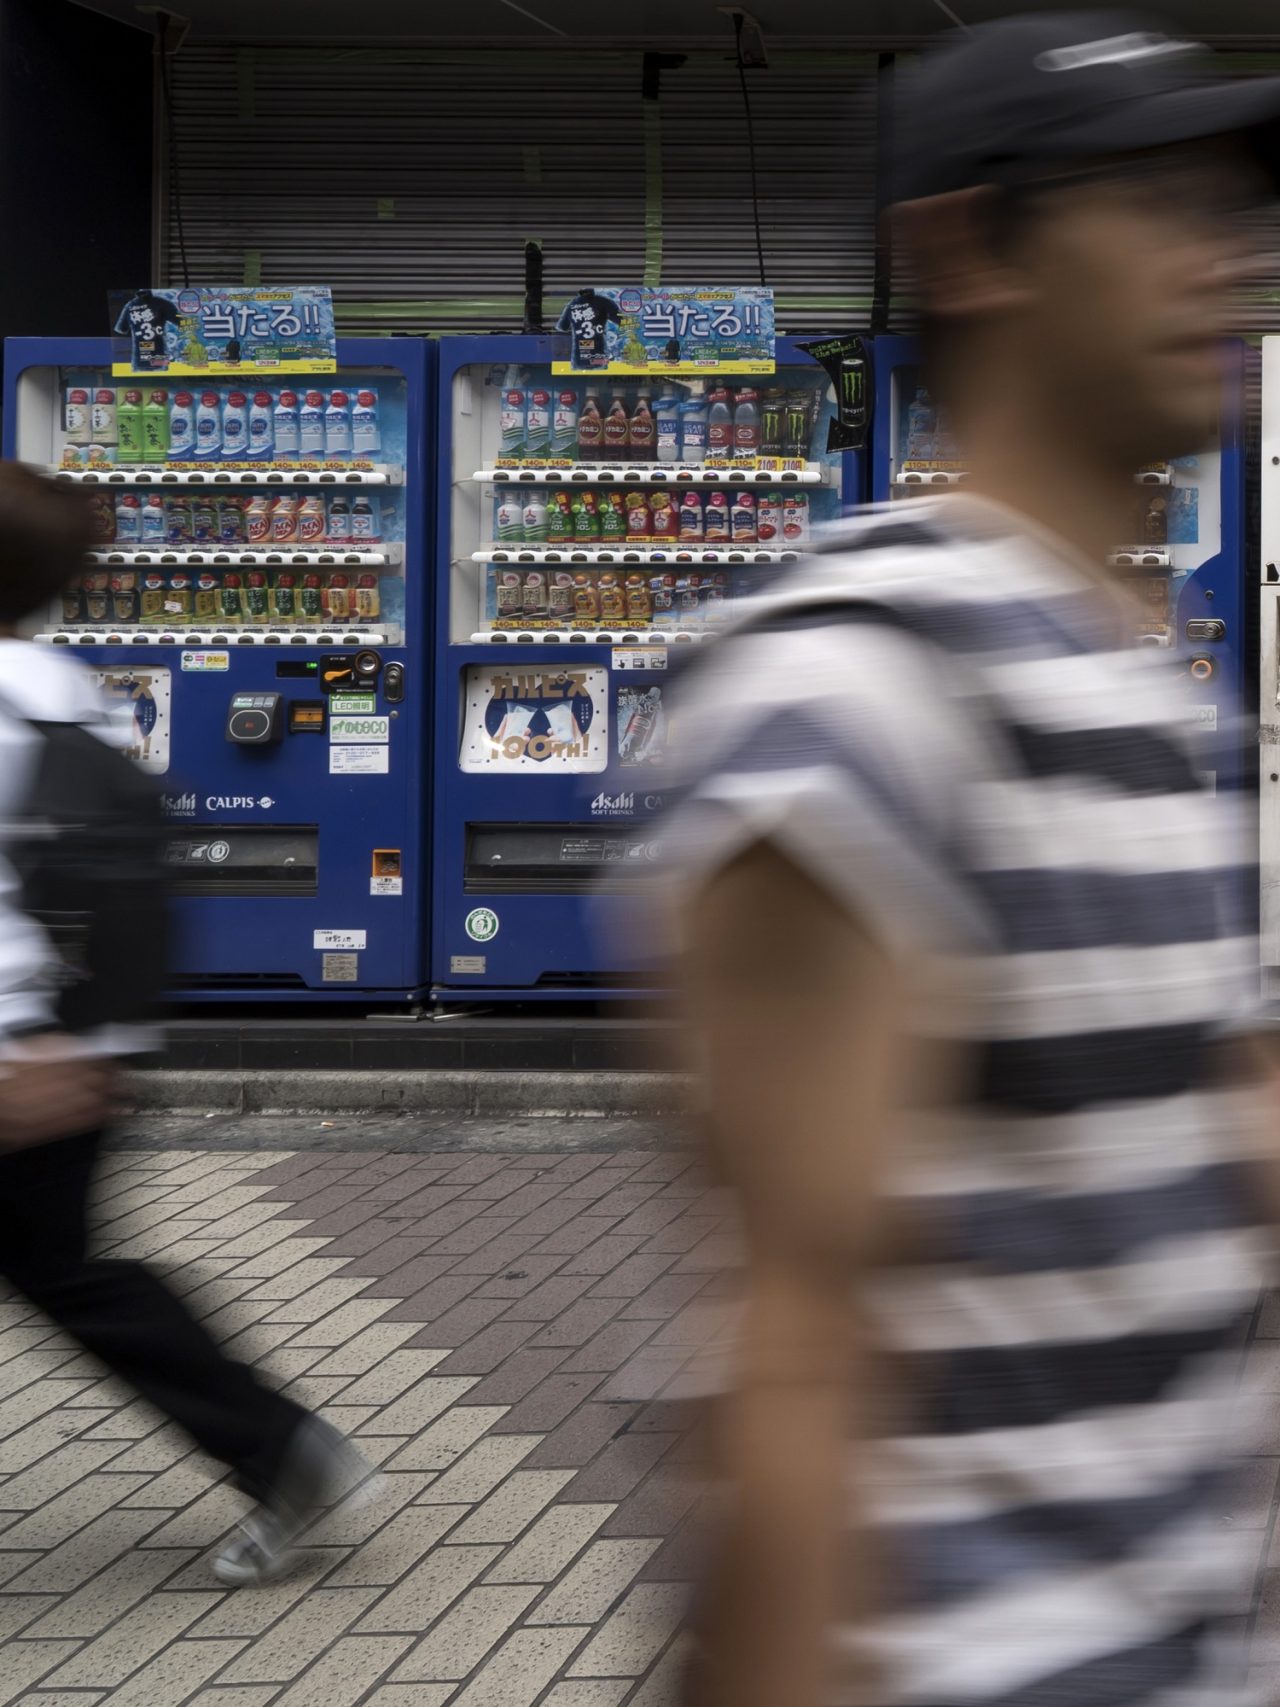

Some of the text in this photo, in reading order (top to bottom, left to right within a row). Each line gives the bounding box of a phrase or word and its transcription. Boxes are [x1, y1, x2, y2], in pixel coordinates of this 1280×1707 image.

[490, 673, 589, 700] カルピス
[334, 701, 370, 711] LED照明
[205, 796, 254, 811] CALPIS
[591, 792, 635, 810] Asahi
